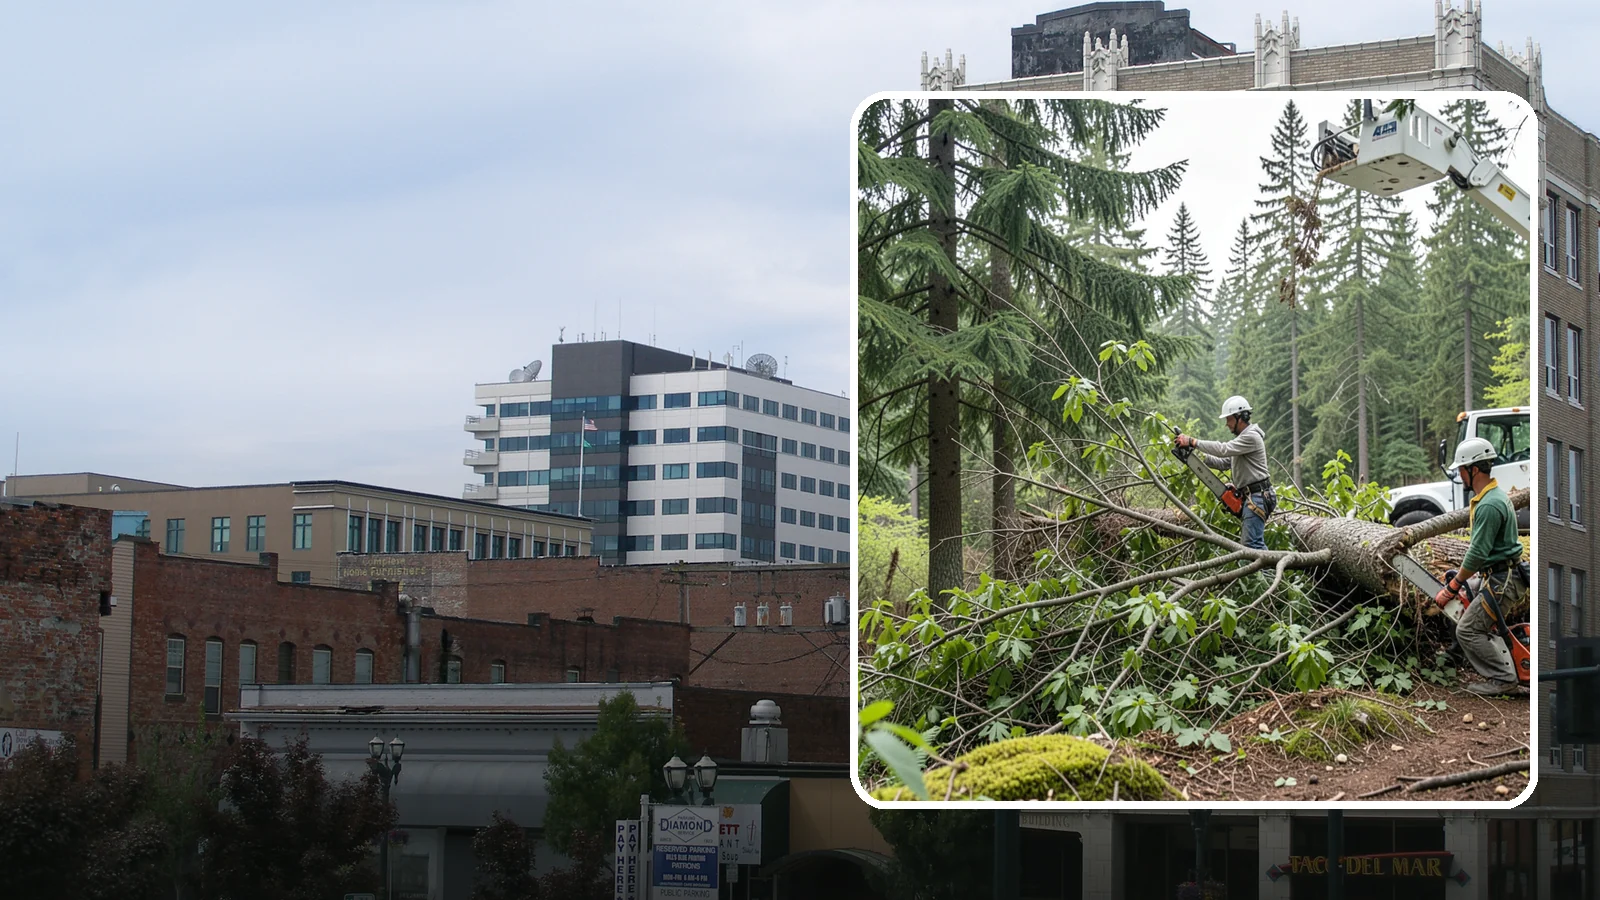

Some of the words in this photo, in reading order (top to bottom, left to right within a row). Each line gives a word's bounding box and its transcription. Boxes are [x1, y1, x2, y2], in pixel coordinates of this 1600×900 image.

[370, 566, 427, 576] Furnishers
[660, 818, 713, 832] DIAMOND
[1022, 815, 1070, 828] BUILDING
[719, 824, 740, 835] ETT
[617, 825, 625, 852] PAY
[628, 824, 637, 852] PAY
[719, 839, 740, 848] ANT
[655, 845, 688, 853] RESERVED
[689, 846, 716, 854] PARKING
[671, 862, 701, 870] PATRONS
[1289, 855, 1329, 874] TAC
[1346, 856, 1385, 875] DEL
[1392, 857, 1442, 876] MAR
[616, 856, 625, 893] HERE
[627, 856, 636, 893] HERE
[660, 888, 682, 897] PUBLIC
[683, 889, 710, 898] PARKING
